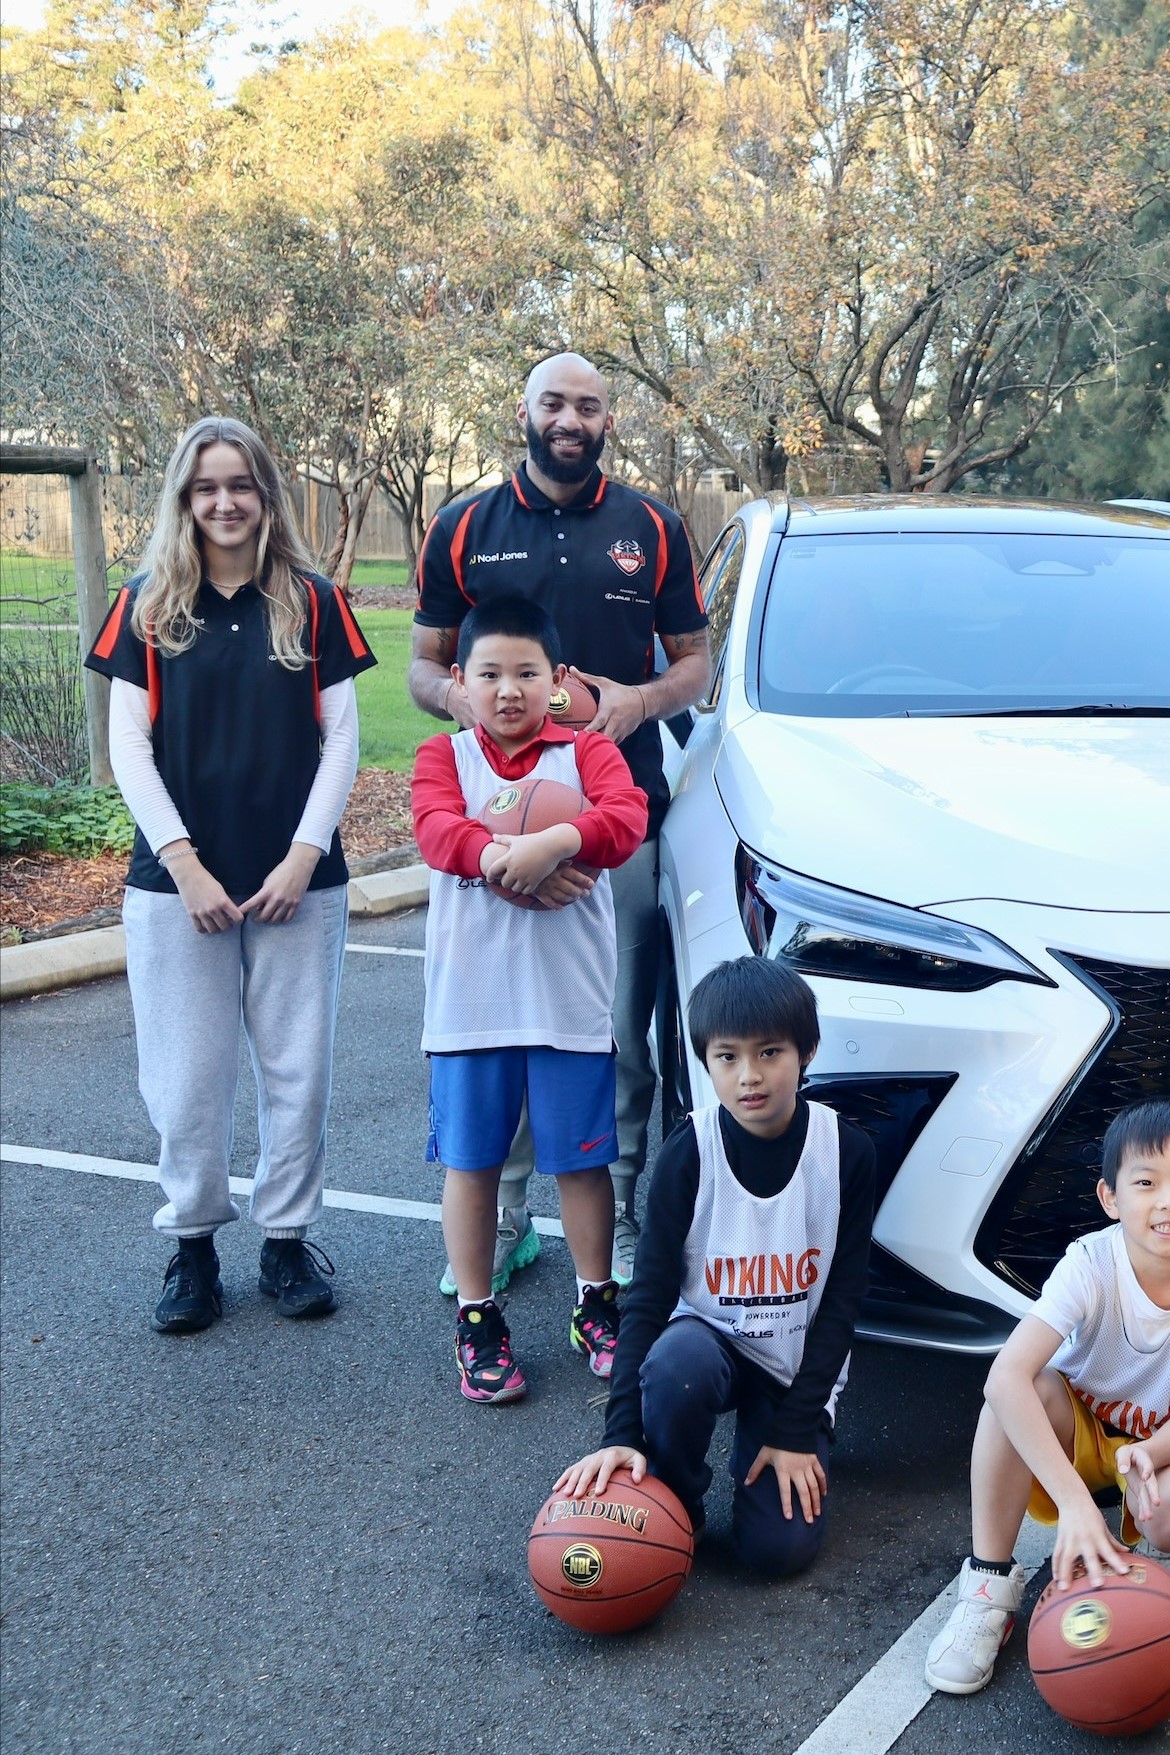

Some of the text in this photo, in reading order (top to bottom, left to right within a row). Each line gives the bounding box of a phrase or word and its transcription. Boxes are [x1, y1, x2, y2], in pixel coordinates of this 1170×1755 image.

[477, 551, 528, 564] Noel Jones
[569, 1556, 591, 1576] NBL
